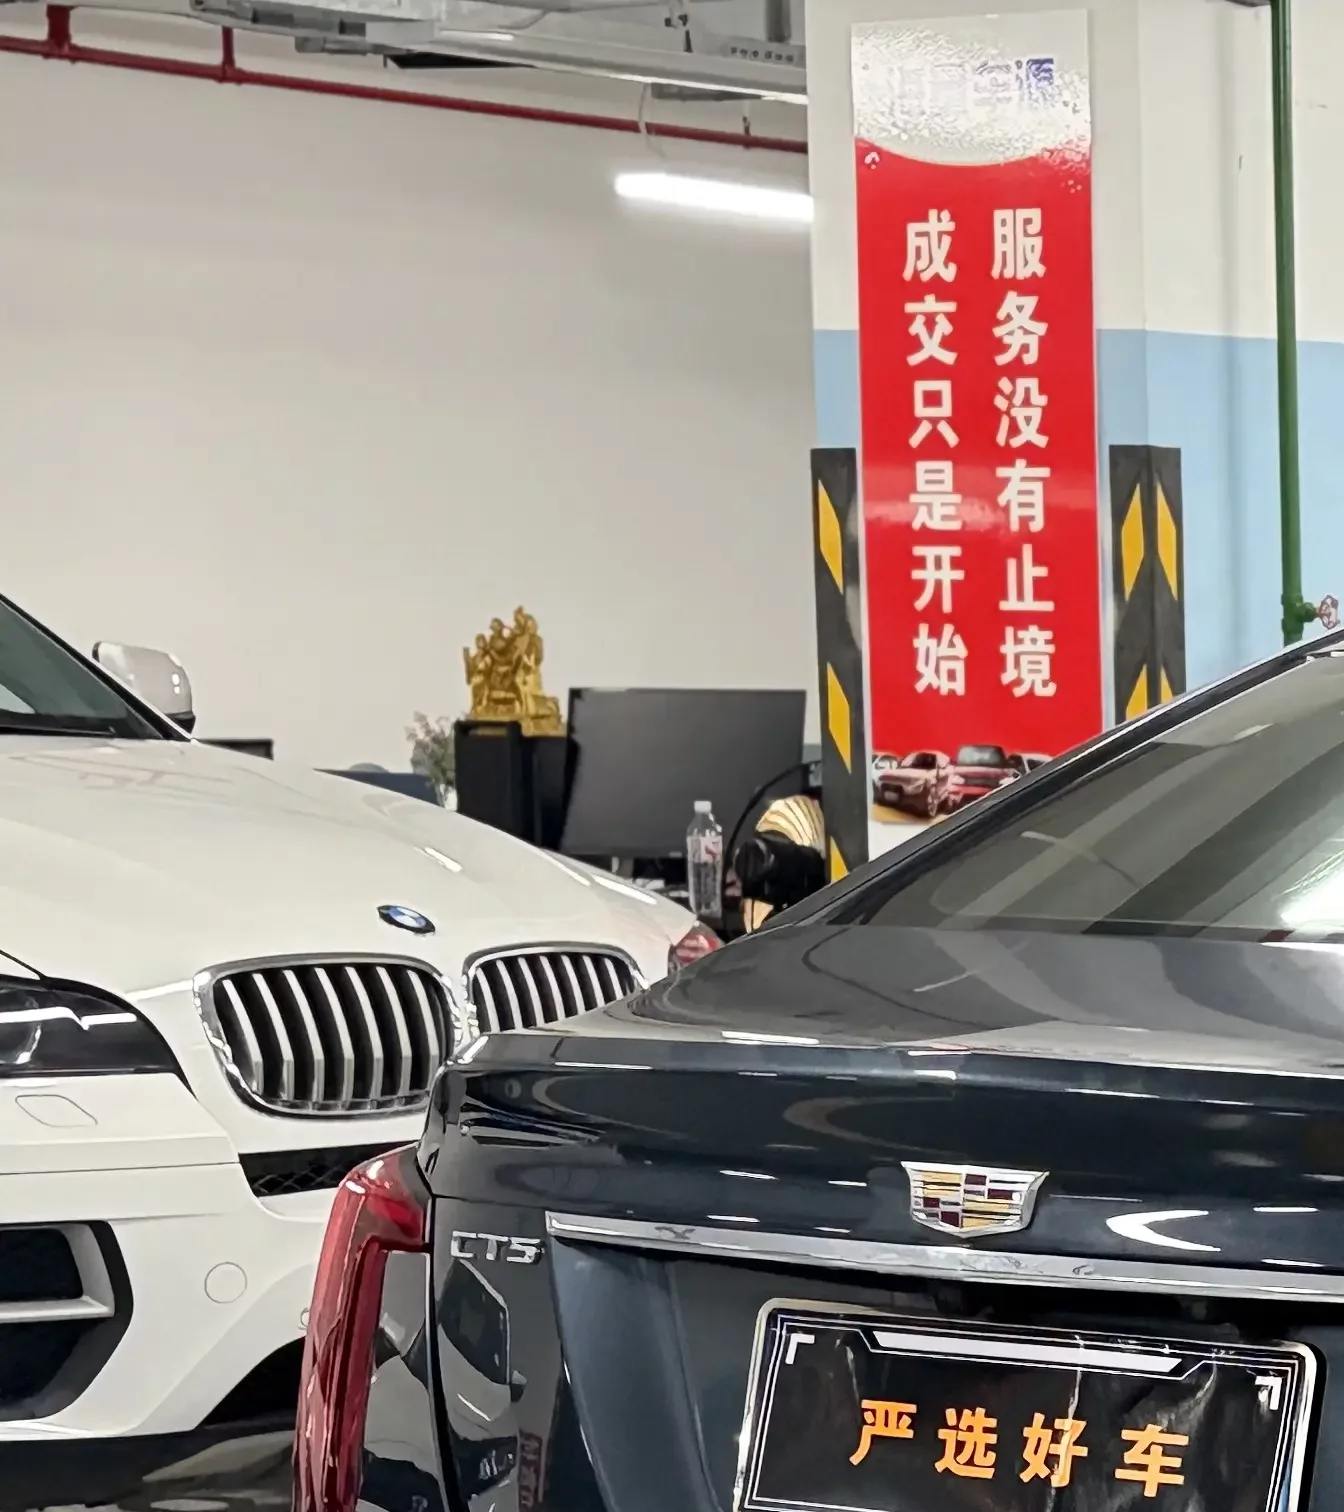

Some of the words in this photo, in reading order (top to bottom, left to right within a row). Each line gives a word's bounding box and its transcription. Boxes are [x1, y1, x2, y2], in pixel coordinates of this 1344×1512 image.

[903, 209, 968, 696] 成交只是开始
[990, 208, 1057, 697] 服务没有止境
[849, 1398, 1189, 1499] 严选好车
